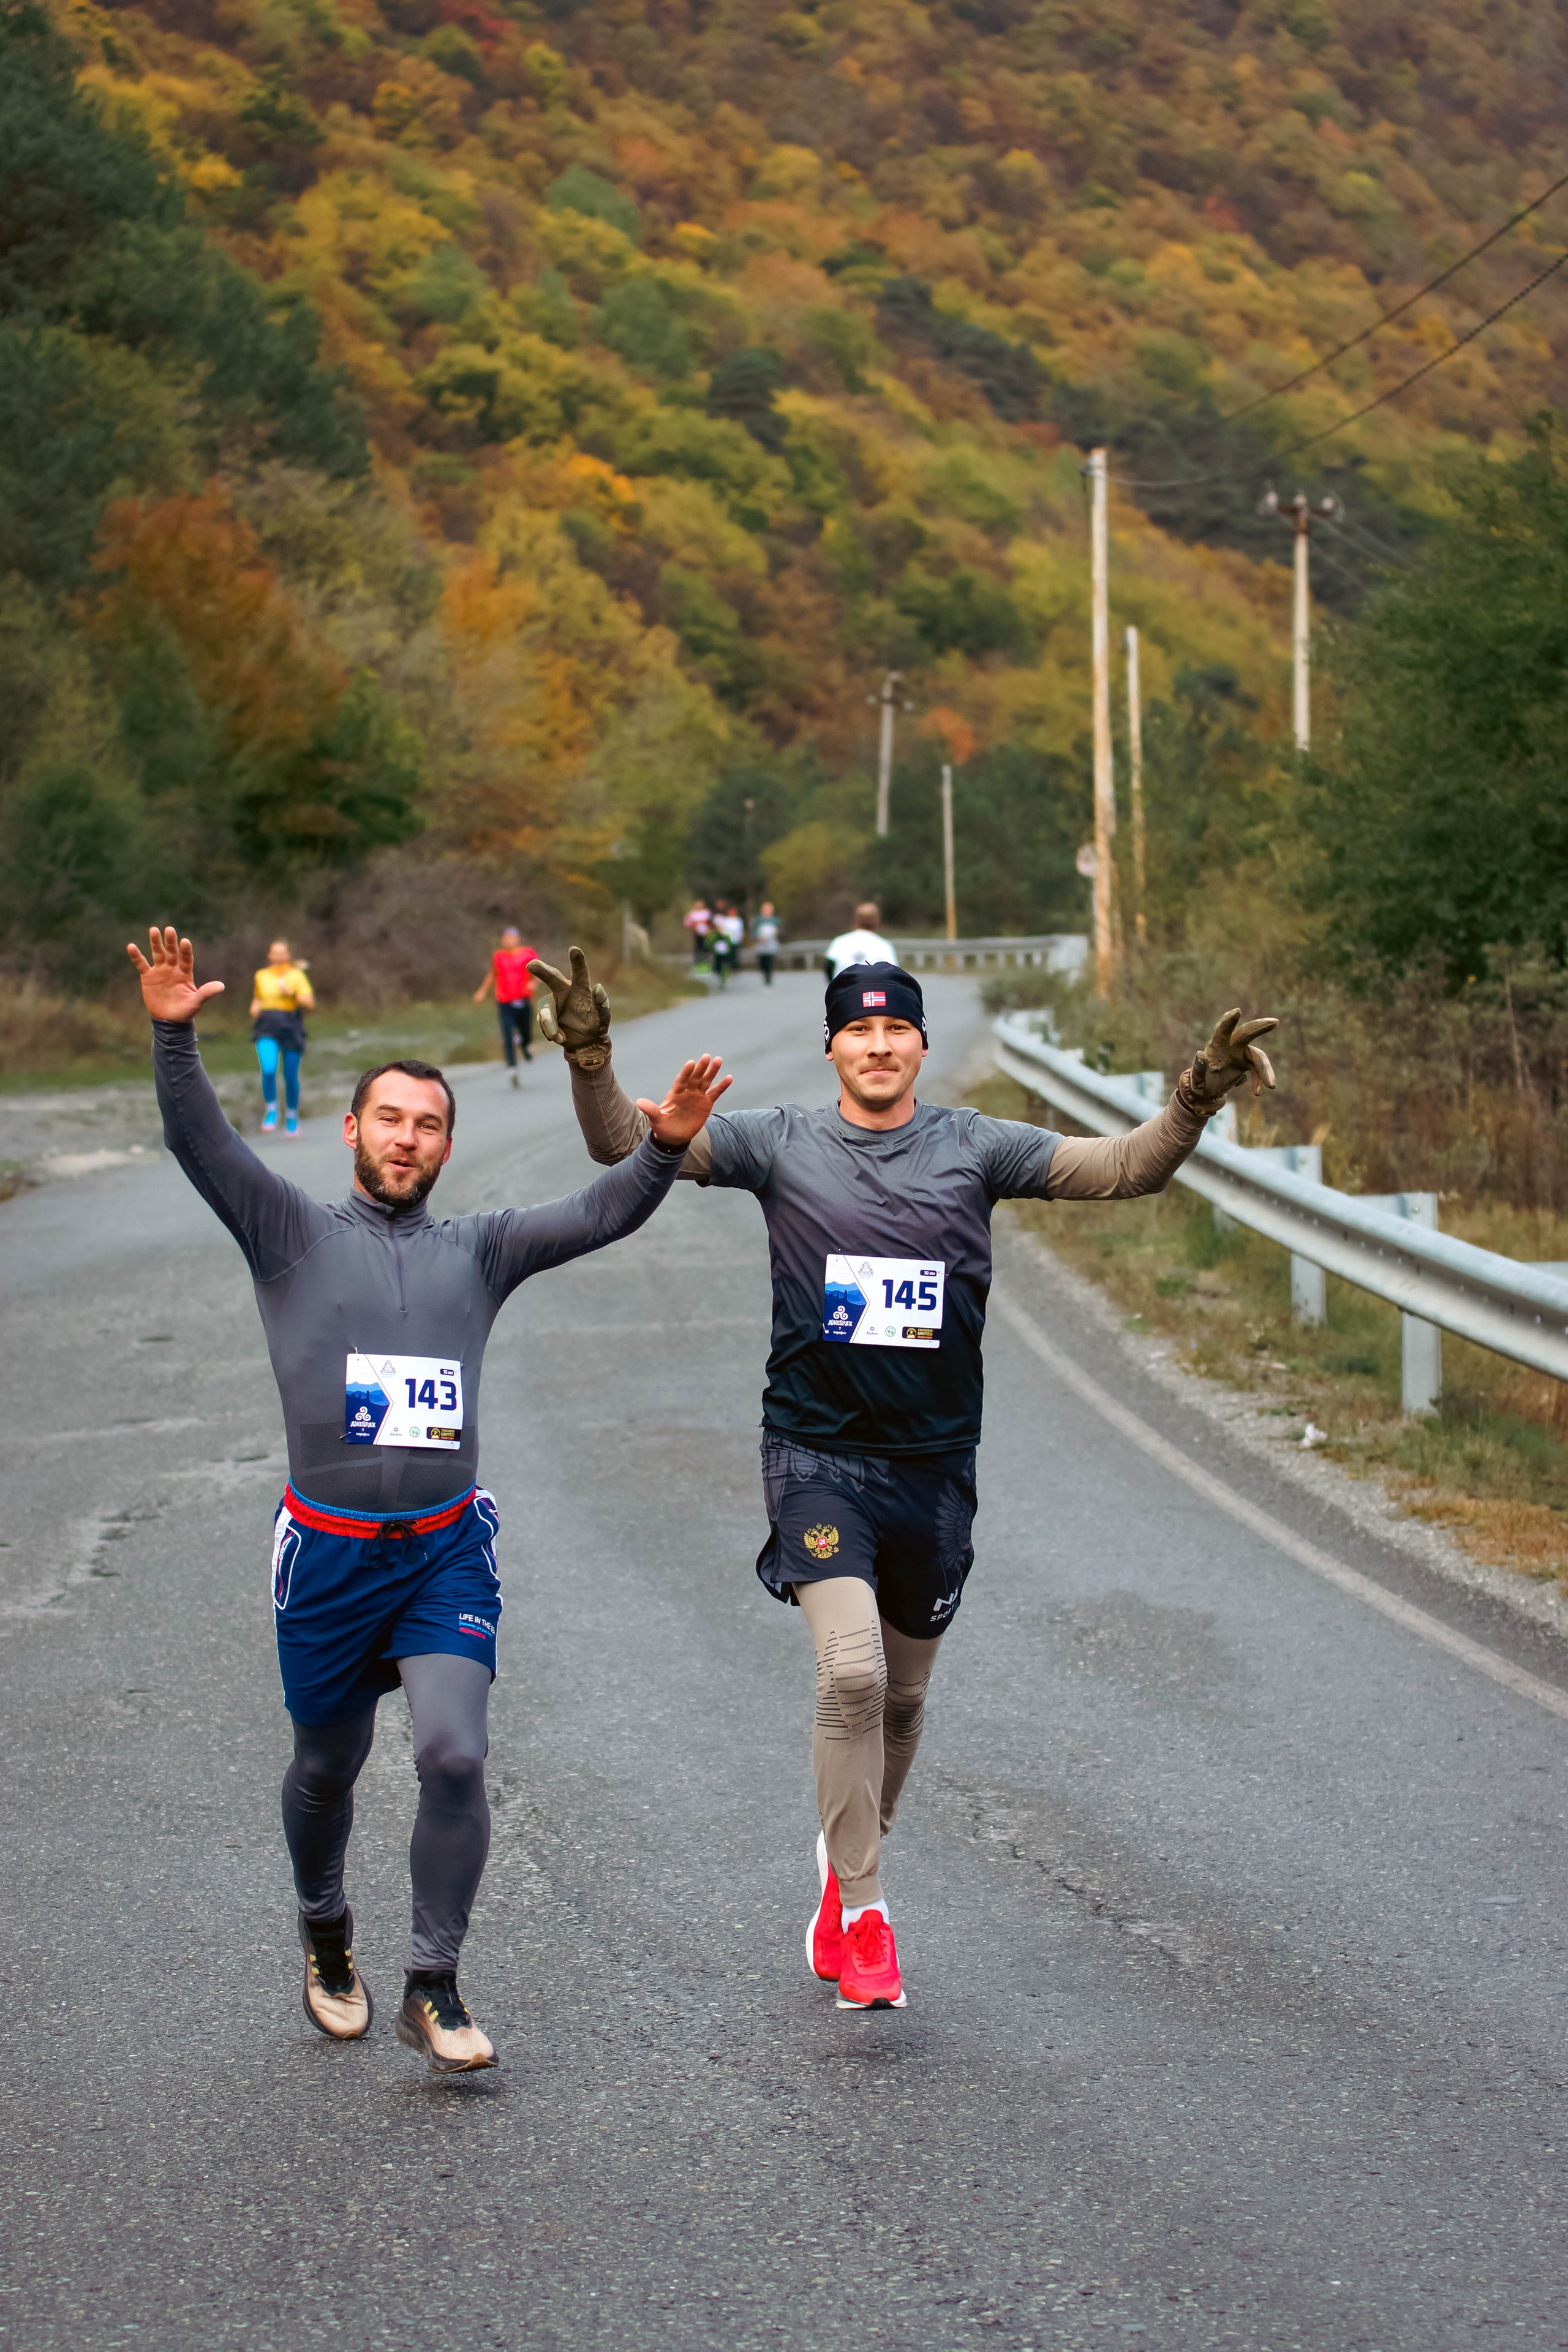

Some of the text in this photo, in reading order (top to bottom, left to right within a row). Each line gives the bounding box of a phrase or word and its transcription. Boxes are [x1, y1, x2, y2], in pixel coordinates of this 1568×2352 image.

[882, 1279, 938, 1311] 145
[405, 1378, 457, 1411] 143
[459, 1613, 473, 1622] LIFE
[481, 1619, 491, 1630] THE
